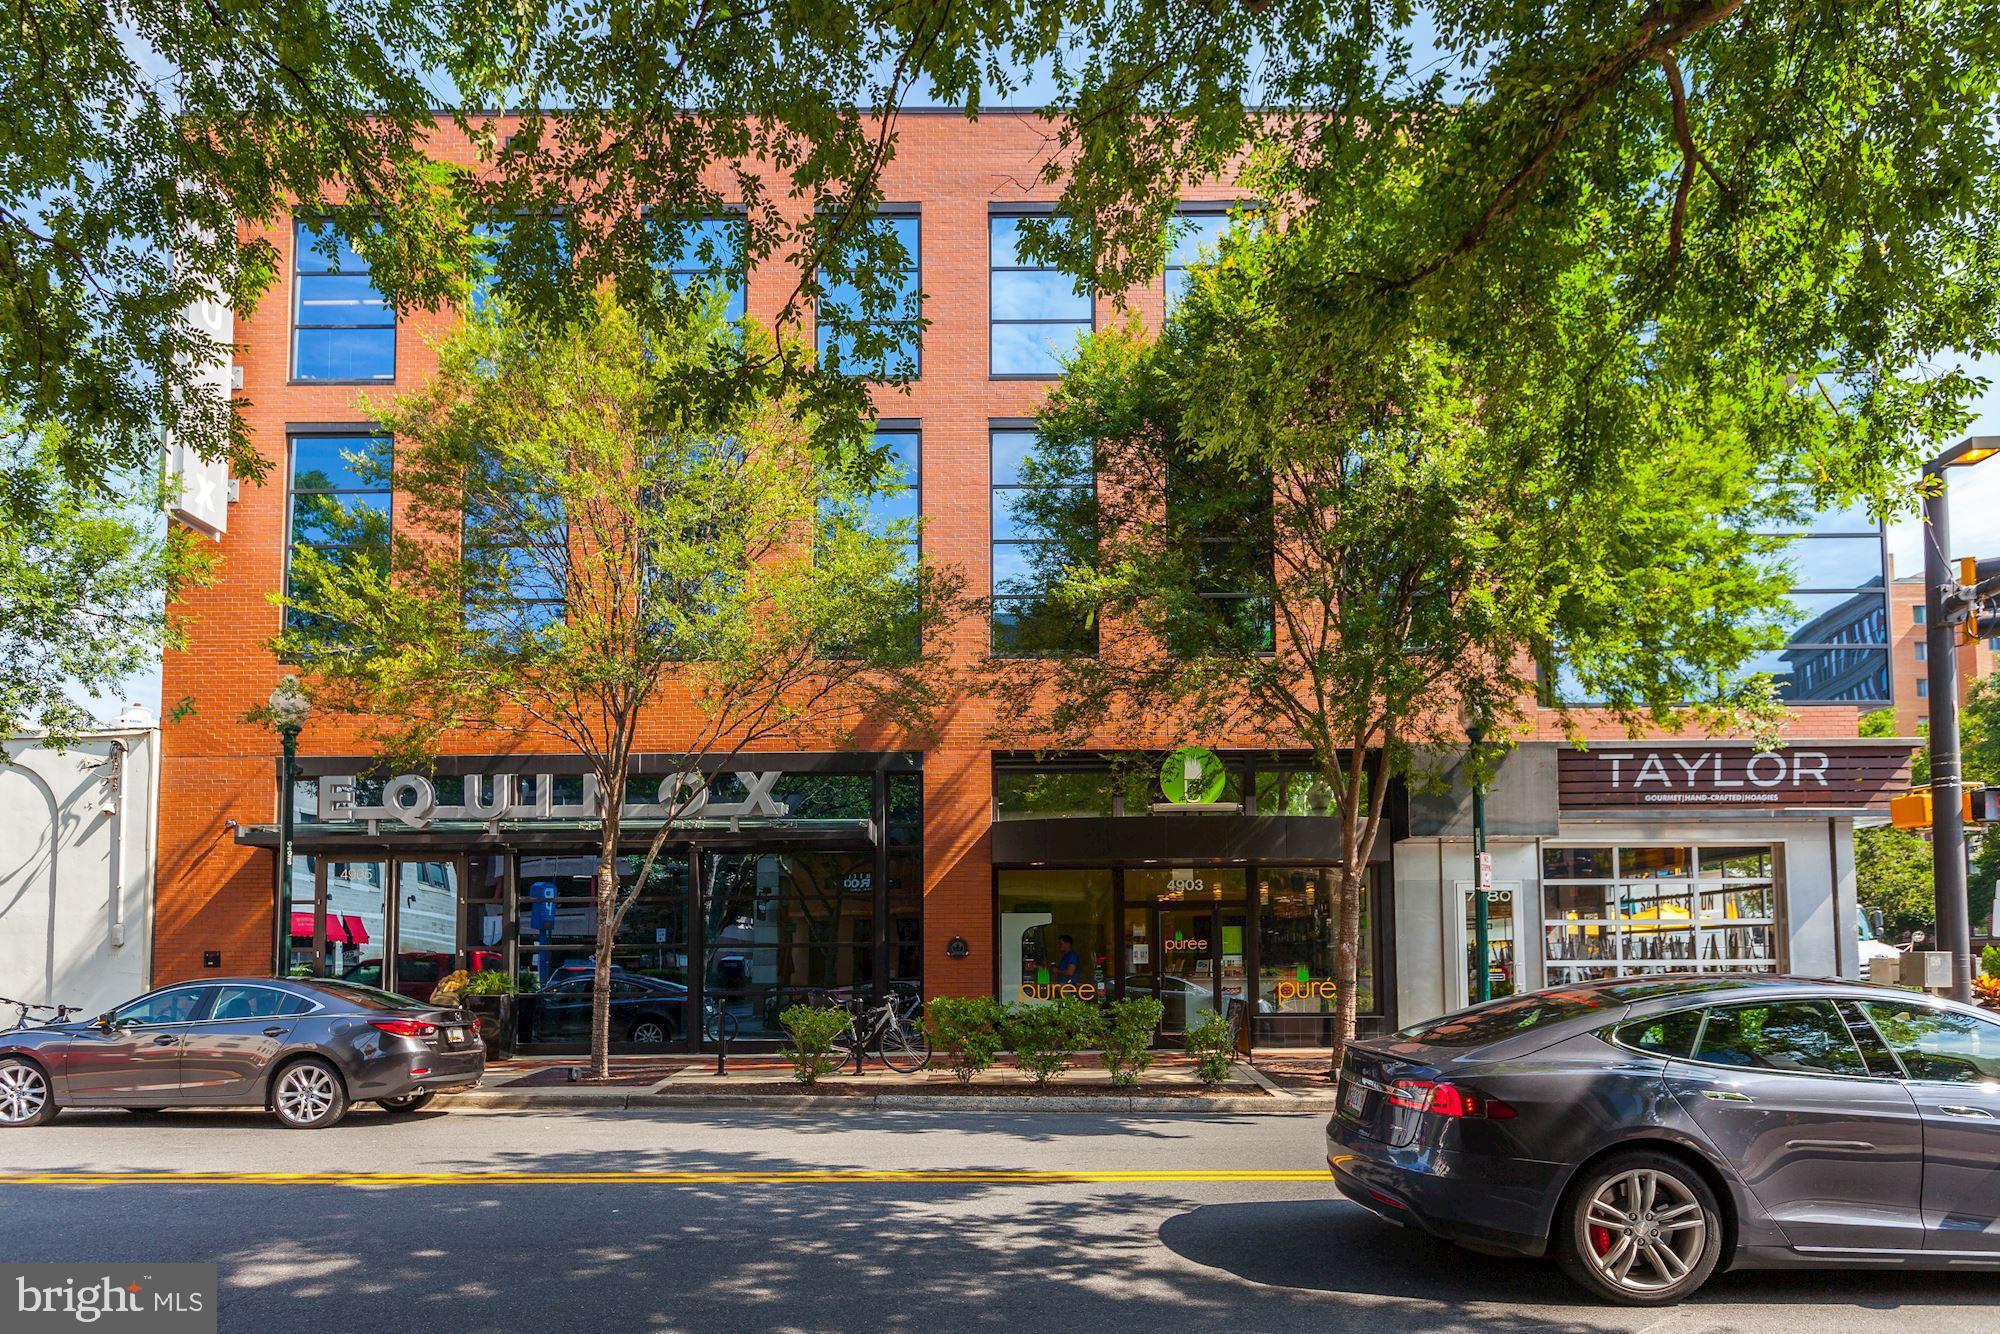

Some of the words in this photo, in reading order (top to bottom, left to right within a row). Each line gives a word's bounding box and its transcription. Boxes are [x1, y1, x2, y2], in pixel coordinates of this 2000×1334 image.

[1598, 752, 1830, 788] TAYLOR
[1166, 879, 1204, 891] 4903
[1467, 890, 1511, 902] 780
